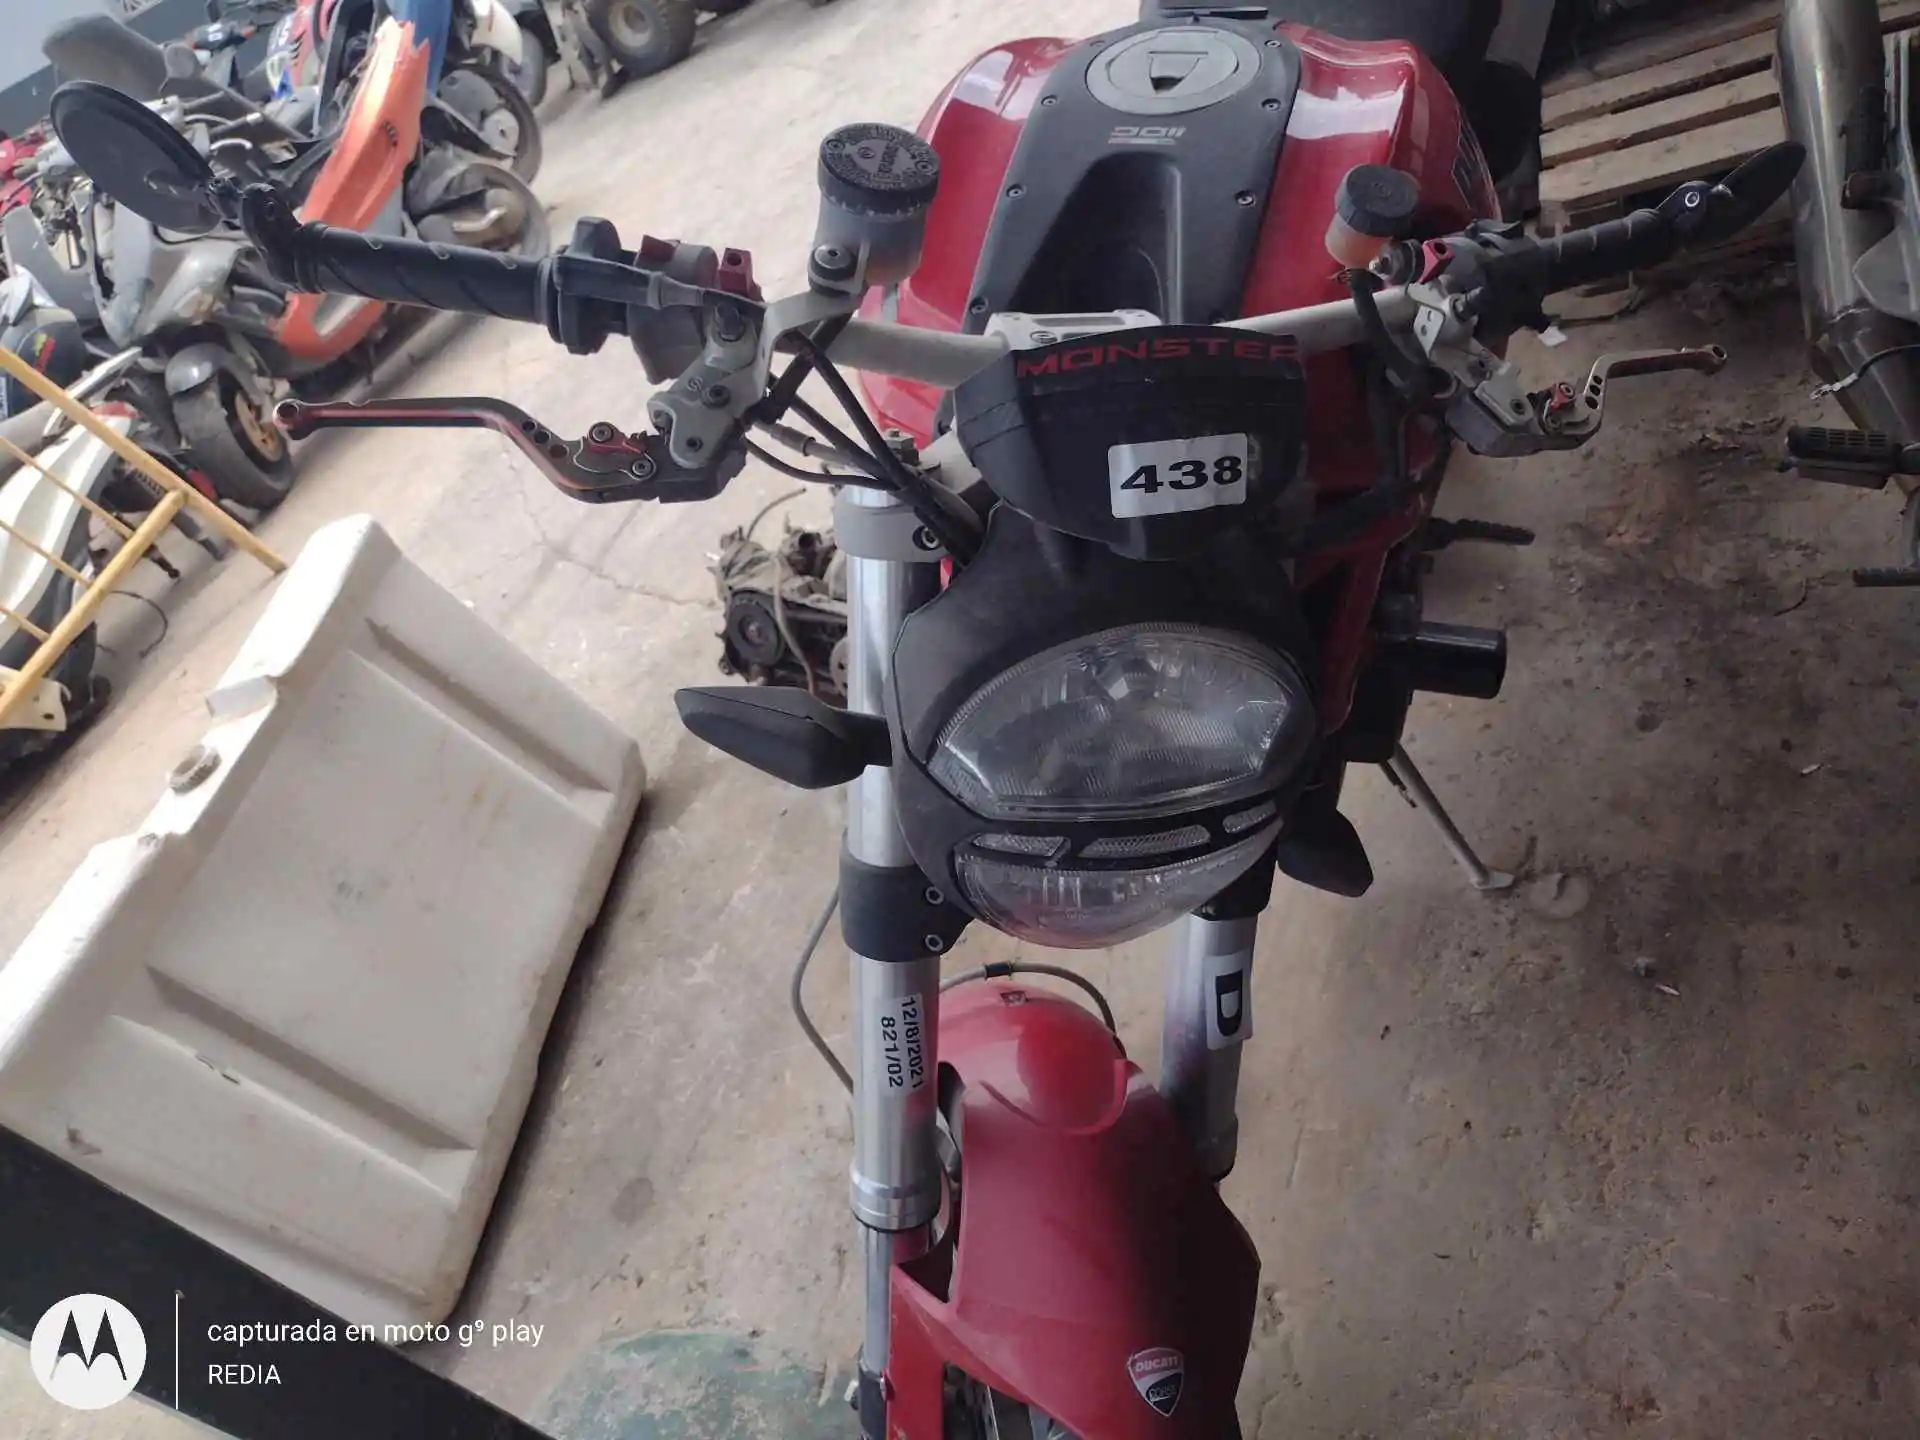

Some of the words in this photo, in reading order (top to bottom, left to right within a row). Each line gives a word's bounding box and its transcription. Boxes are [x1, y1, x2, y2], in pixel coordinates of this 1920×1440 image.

[1016, 338, 1299, 378] MONSTER
[1120, 455, 1243, 494] 438
[1215, 968, 1243, 1037] D
[881, 1016, 904, 1088] 821/02
[901, 996, 926, 1089] 12/8/2021
[1135, 1356, 1178, 1372] DUCATI
